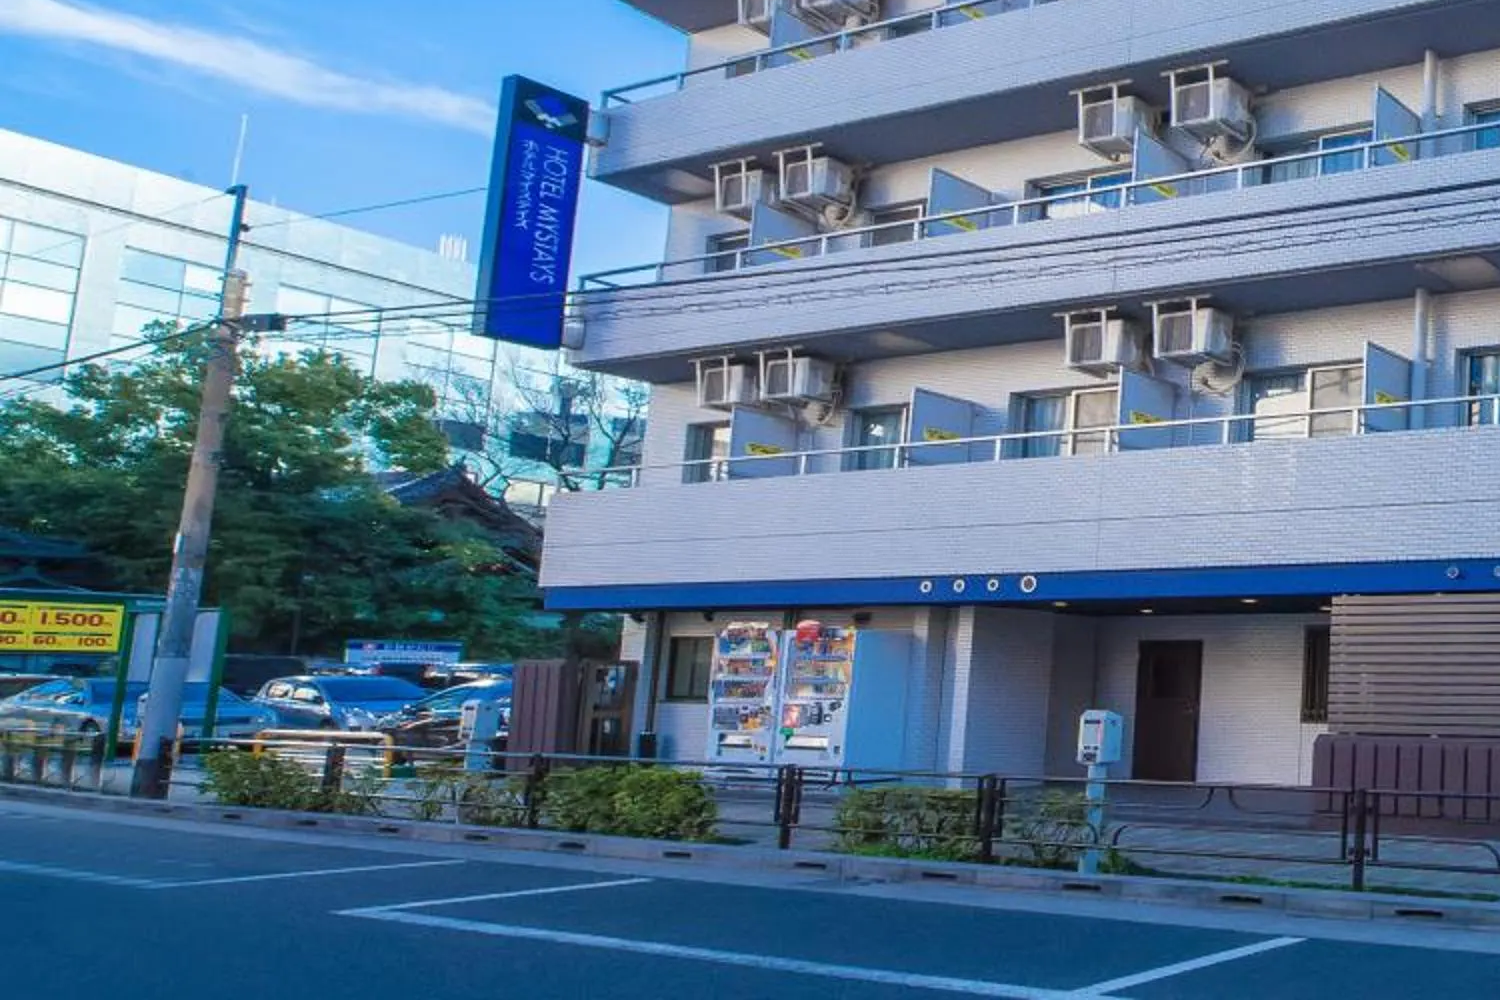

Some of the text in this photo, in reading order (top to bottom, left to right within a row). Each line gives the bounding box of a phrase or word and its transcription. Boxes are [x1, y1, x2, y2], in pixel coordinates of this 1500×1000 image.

[529, 144, 569, 285] HOTEL MYSTAYS
[33, 635, 56, 645] 60
[78, 637, 106, 647] 100
